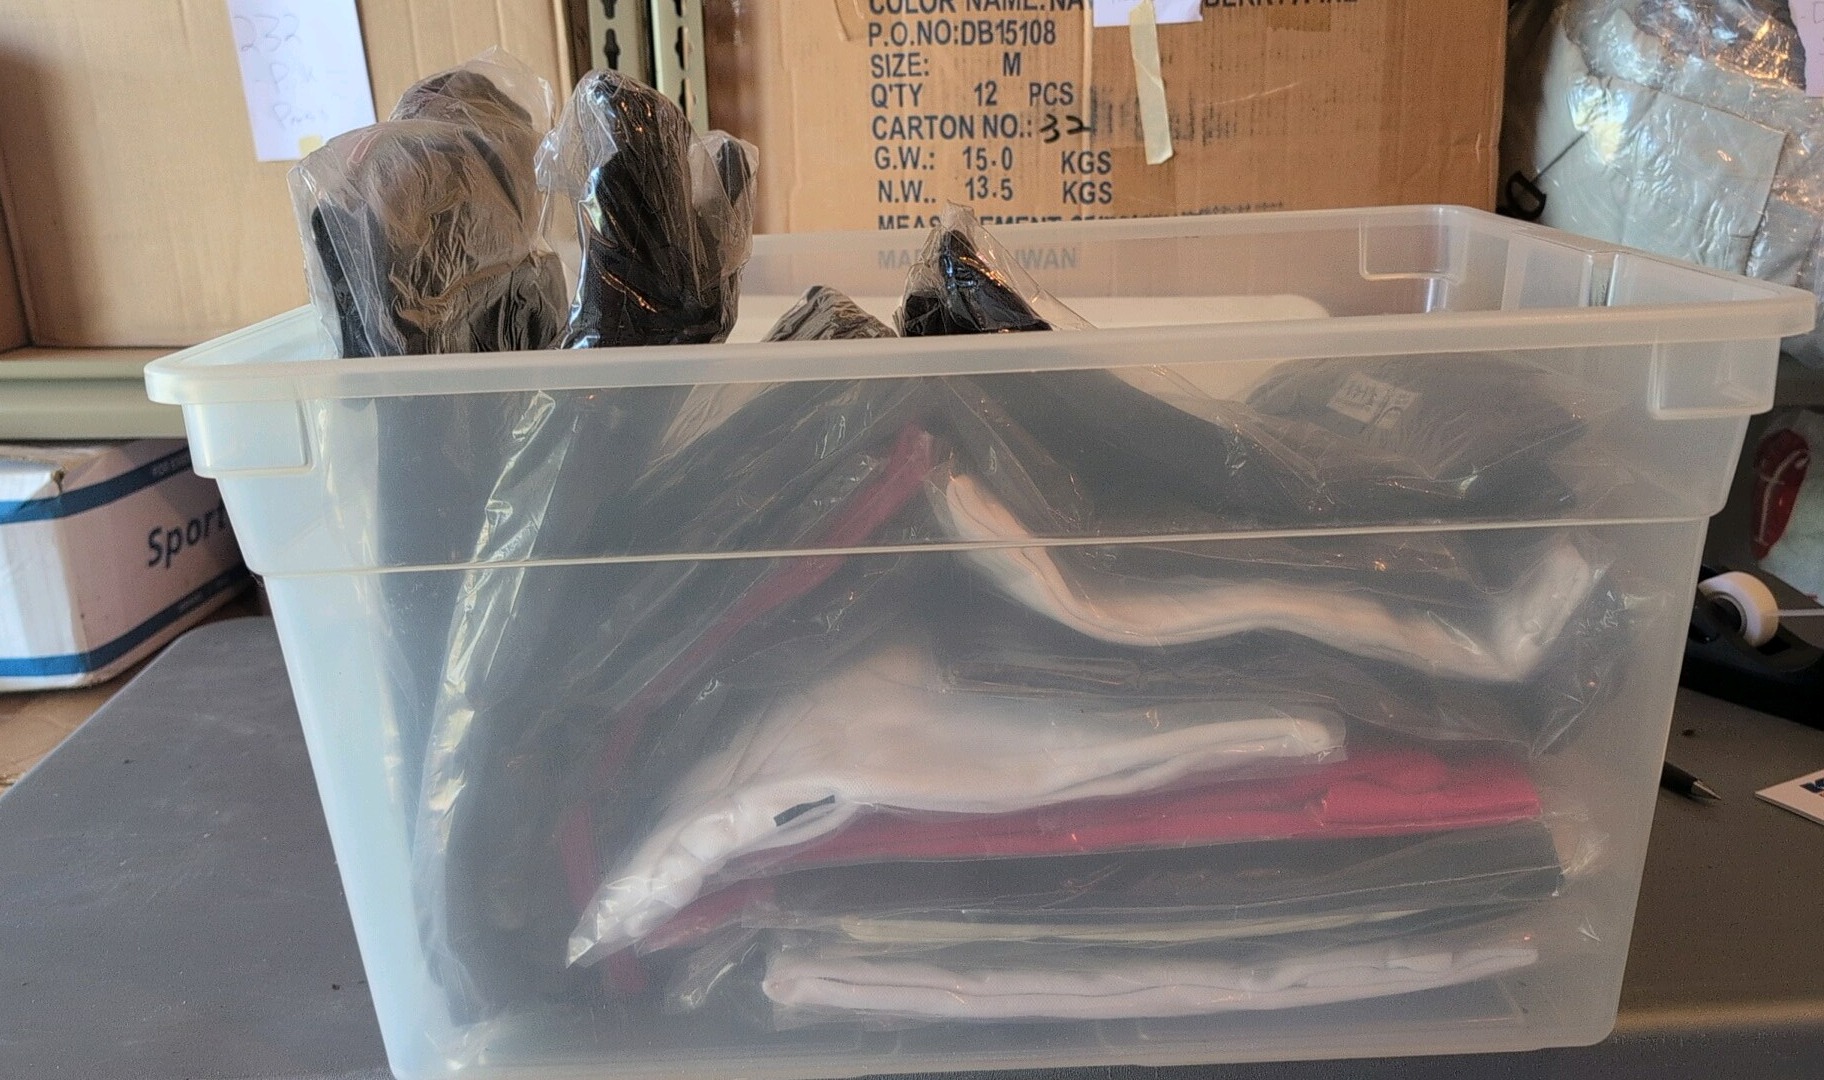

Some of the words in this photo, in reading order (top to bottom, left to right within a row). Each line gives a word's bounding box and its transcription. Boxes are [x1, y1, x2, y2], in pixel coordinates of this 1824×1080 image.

[869, 0, 956, 15] COLOR
[868, 19, 1056, 47] P.O.NO:DB15108
[870, 52, 930, 79] SIZE:
[1003, 52, 1021, 77] M
[871, 83, 923, 109] Q'TY
[974, 80, 997, 107] 12
[1029, 81, 1074, 107] PCS
[872, 115, 975, 140] CARTON
[983, 113, 1032, 139] NO.:
[1039, 113, 1097, 144] 32
[874, 146, 935, 171] G.W.:
[962, 146, 1014, 171] 15.0
[1060, 150, 1112, 175] KGS
[965, 175, 1014, 201] 13.5
[1062, 181, 1113, 205] KGS
